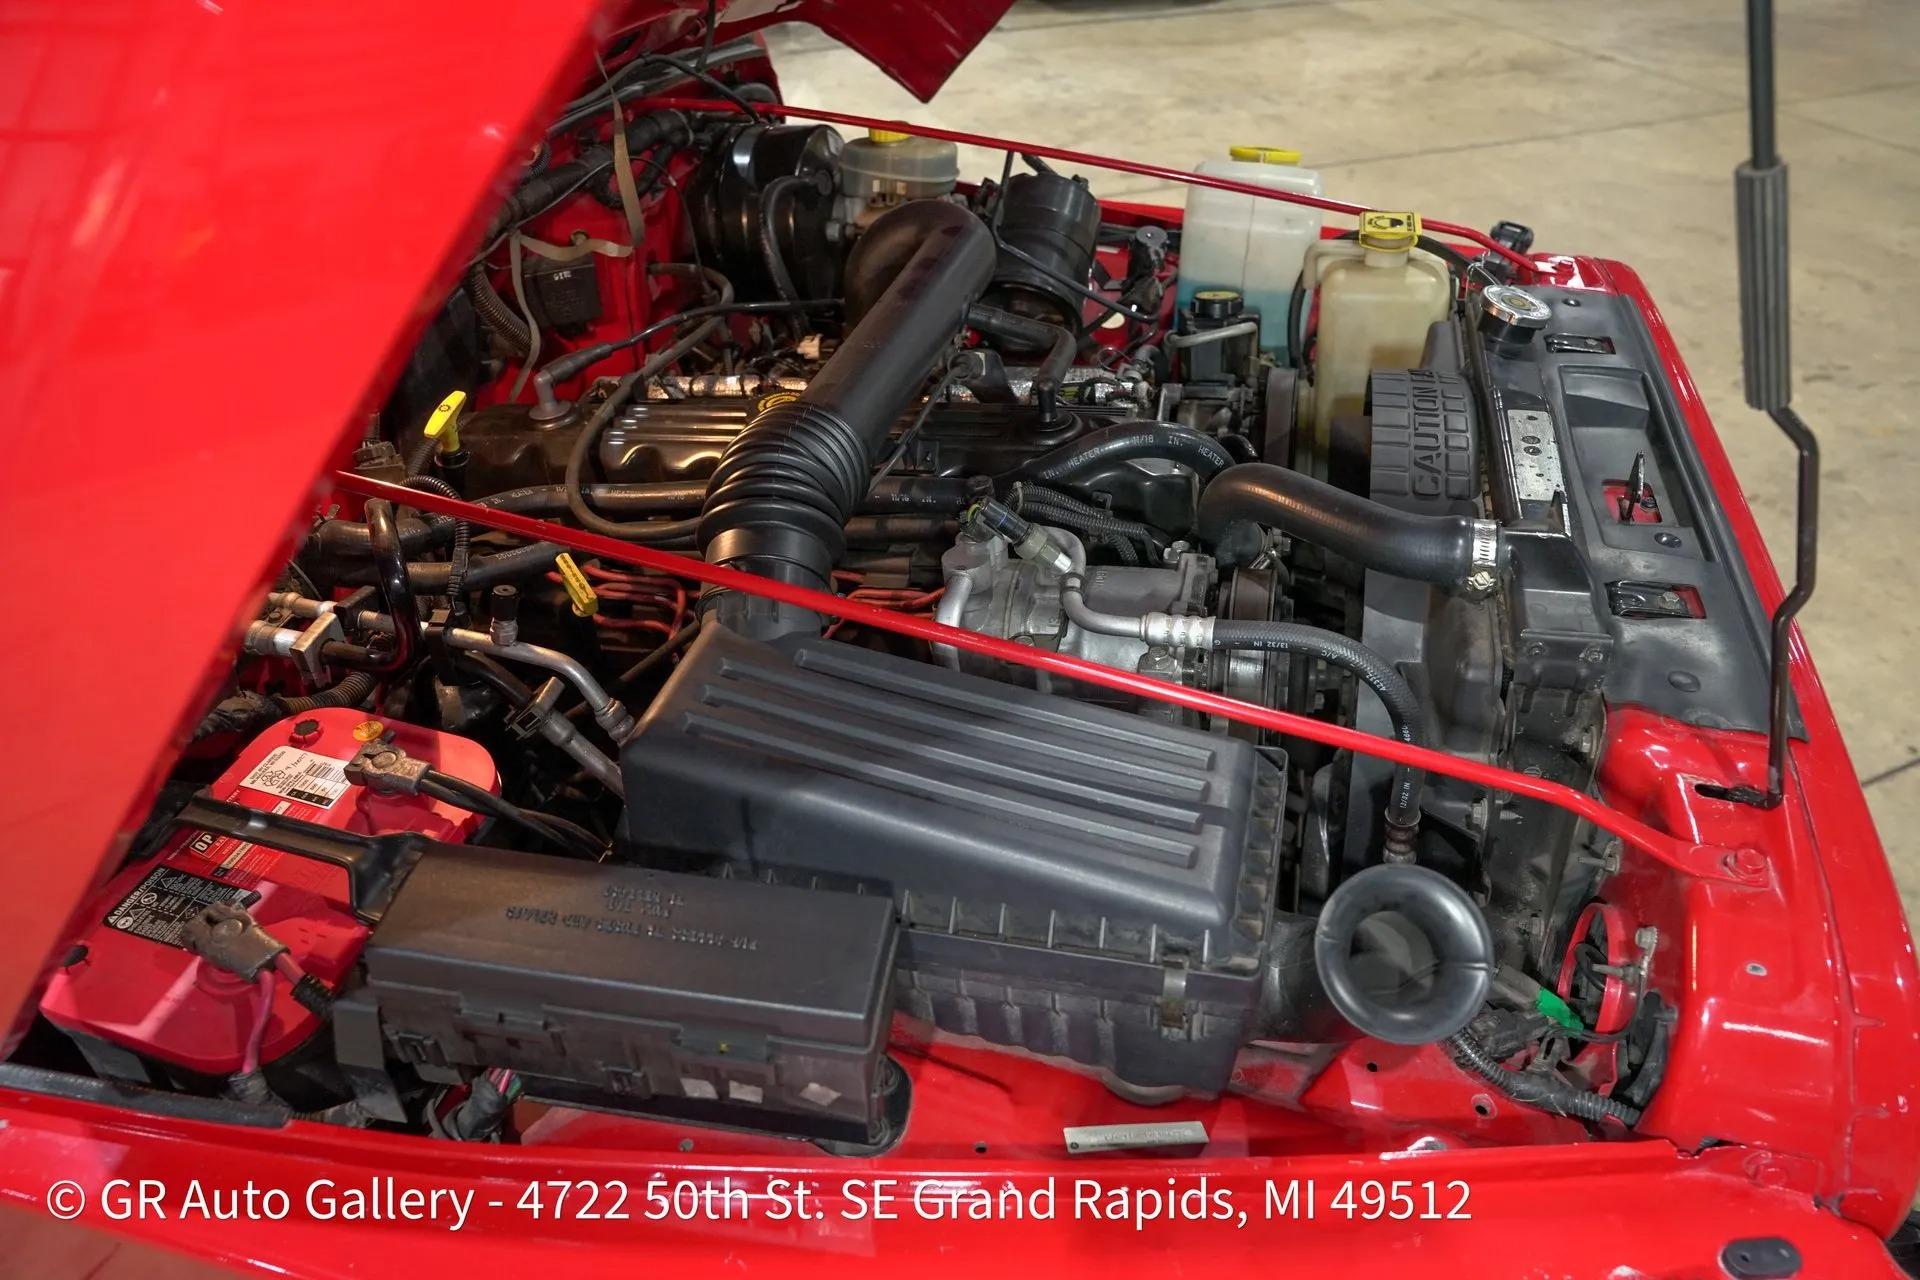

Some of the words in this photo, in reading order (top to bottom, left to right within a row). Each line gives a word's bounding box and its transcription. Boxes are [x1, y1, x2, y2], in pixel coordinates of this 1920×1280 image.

[1412, 387, 1443, 498] CAUTION
[1066, 445, 1101, 469] HEATER
[1197, 444, 1225, 468] HEATER
[1253, 640, 1265, 648] IN
[1266, 641, 1289, 649] 13/32
[1319, 649, 1340, 660] A/C
[115, 867, 165, 917] DANGER/POISON
